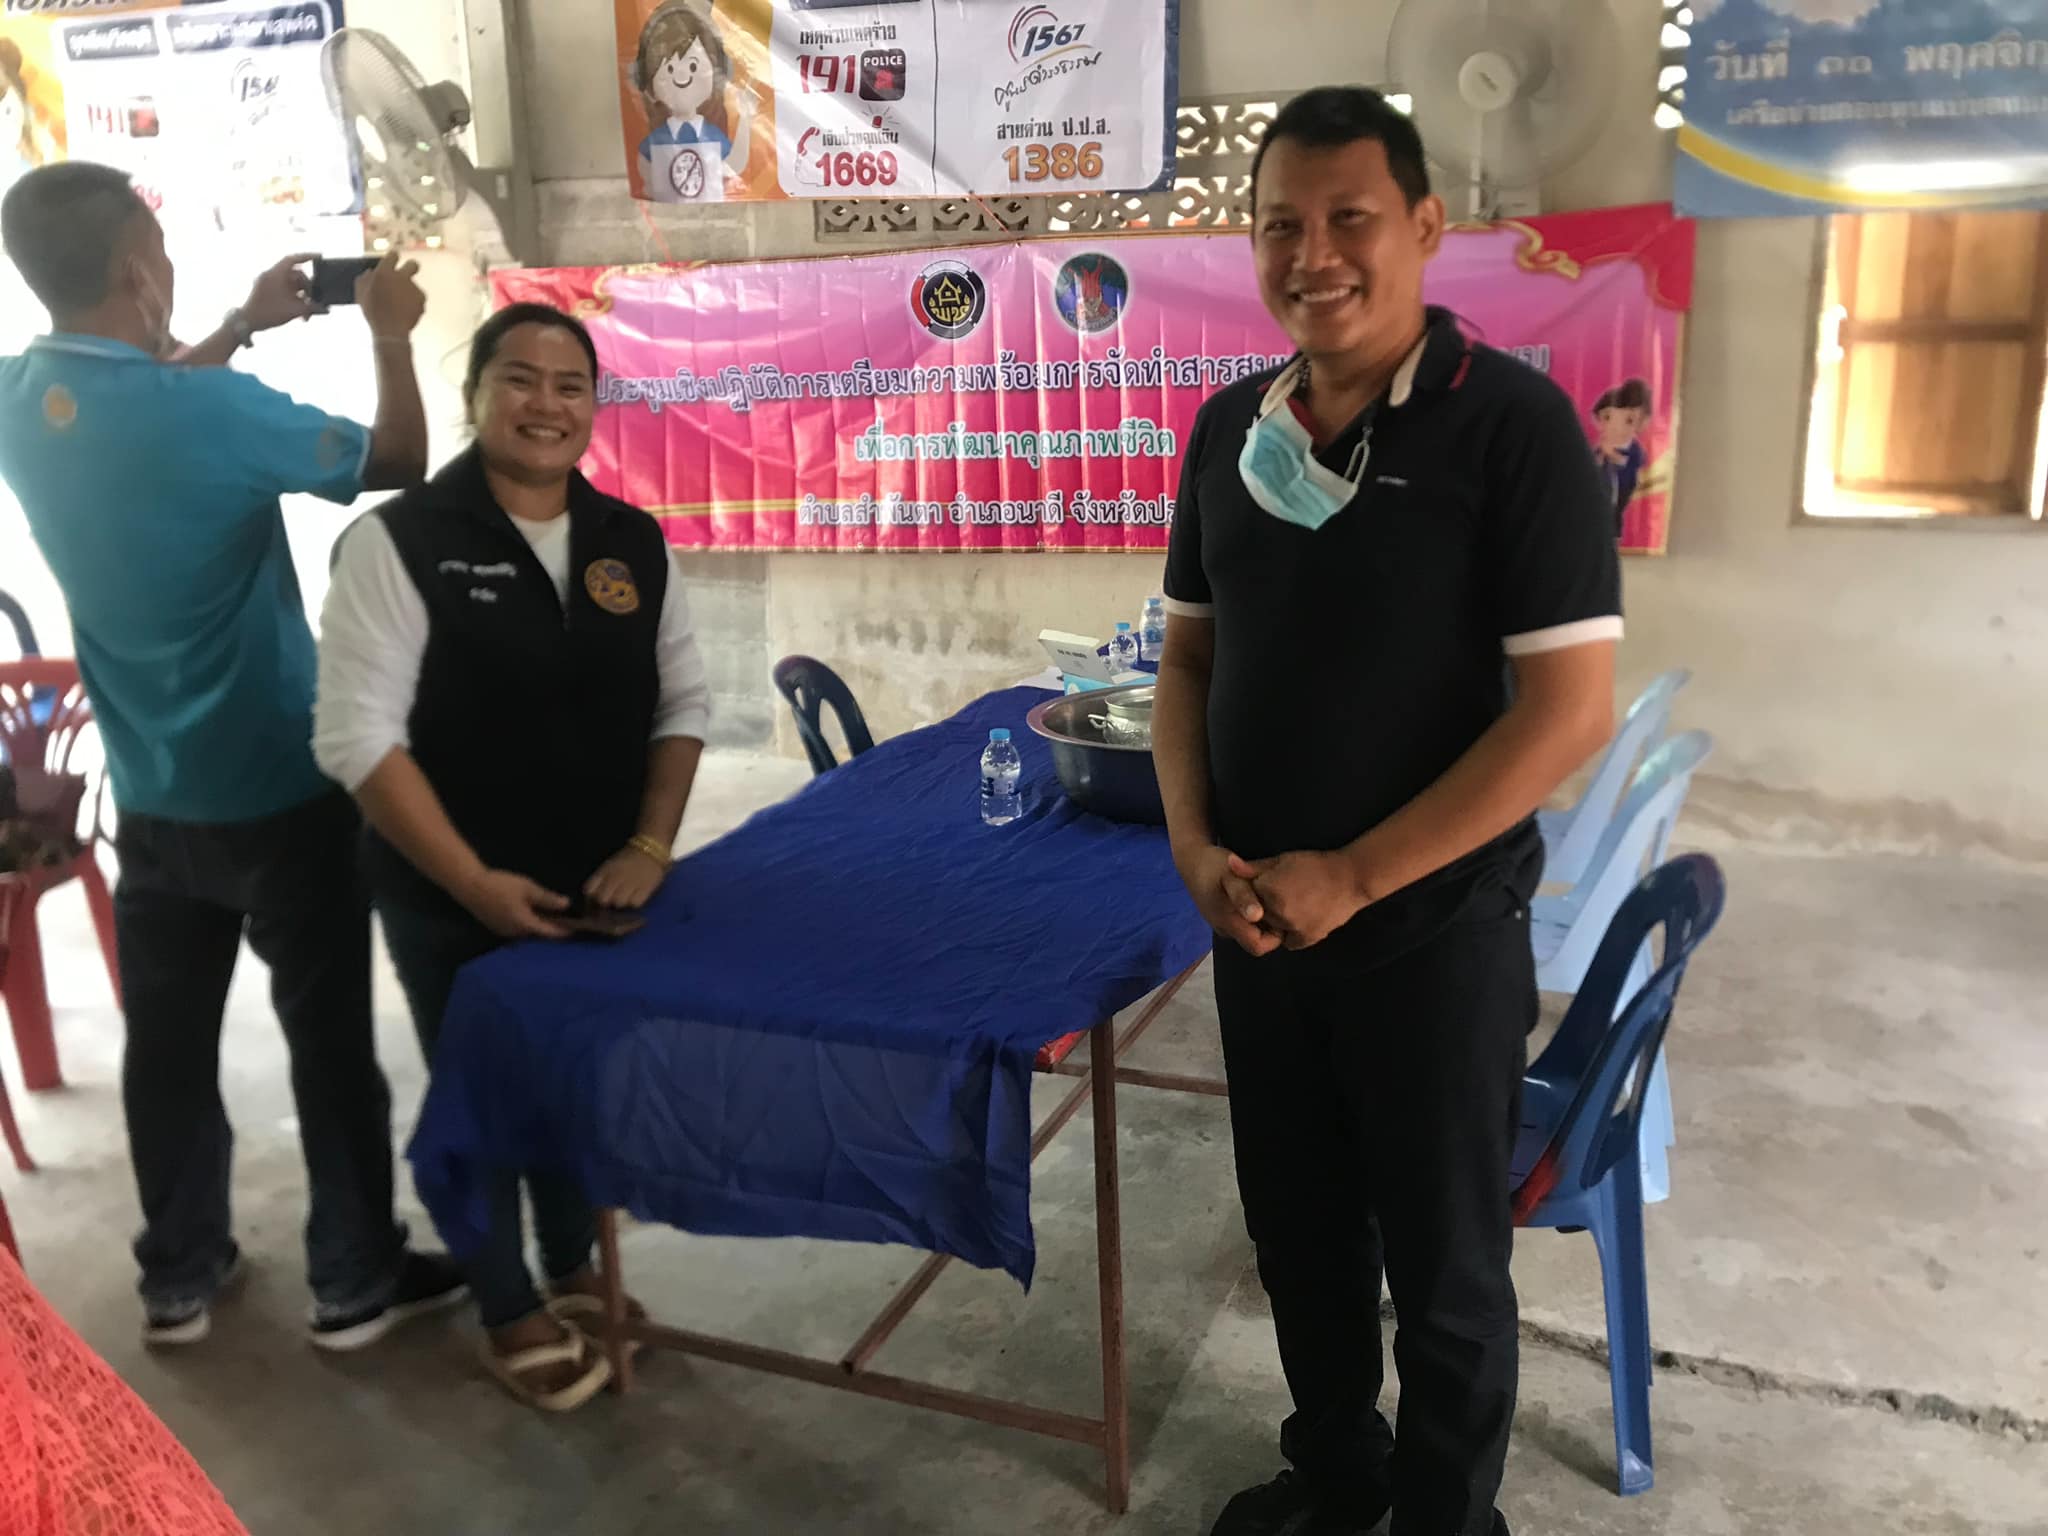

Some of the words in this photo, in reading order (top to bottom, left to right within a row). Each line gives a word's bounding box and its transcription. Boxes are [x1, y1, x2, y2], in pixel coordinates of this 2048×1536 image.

[1022, 24, 1087, 57] 1567
[797, 54, 857, 93] 191
[863, 55, 904, 67] POLICE
[996, 118, 1054, 140] สายด่วน
[1062, 116, 1111, 137] ป.ป.ส.
[815, 151, 898, 187] 1669
[1002, 142, 1104, 182] 1386
[856, 417, 1174, 467] เพื่อการพัฒนาคุณภาพชีวิต
[950, 494, 1063, 523] อำเภอนาดี
